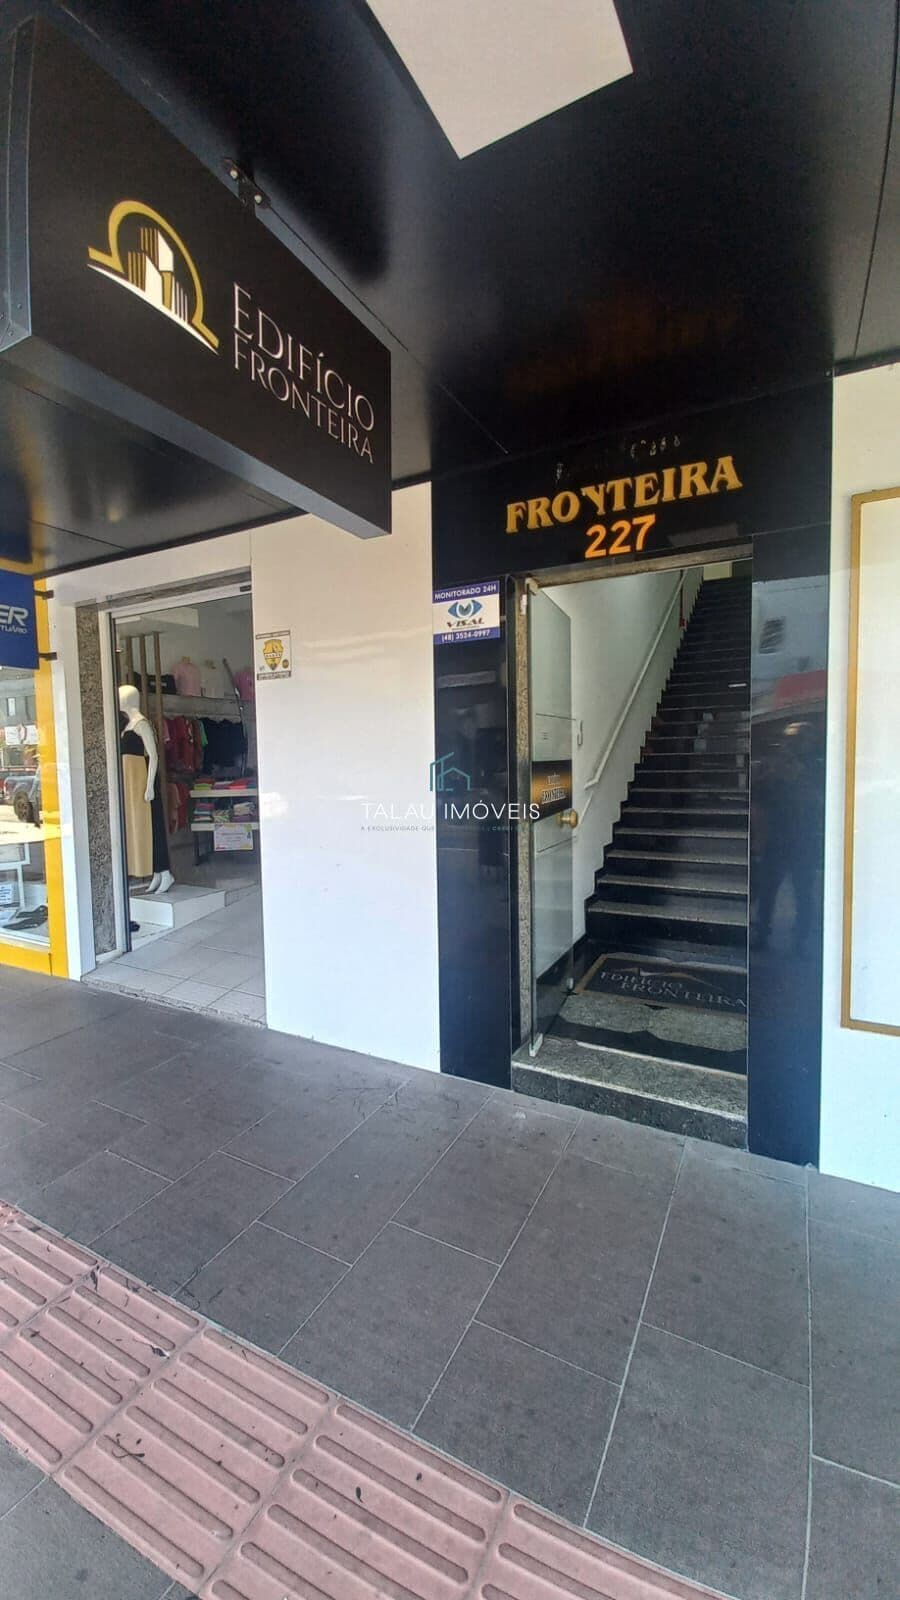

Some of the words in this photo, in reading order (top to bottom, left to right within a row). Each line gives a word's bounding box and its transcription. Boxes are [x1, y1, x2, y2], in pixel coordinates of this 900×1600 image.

[234, 282, 374, 431] EDIFÍCIO
[234, 332, 374, 464] FRONTEIRA
[585, 514, 656, 559] 227
[434, 587, 481, 600] MONITORADO
[483, 584, 497, 593] 24H
